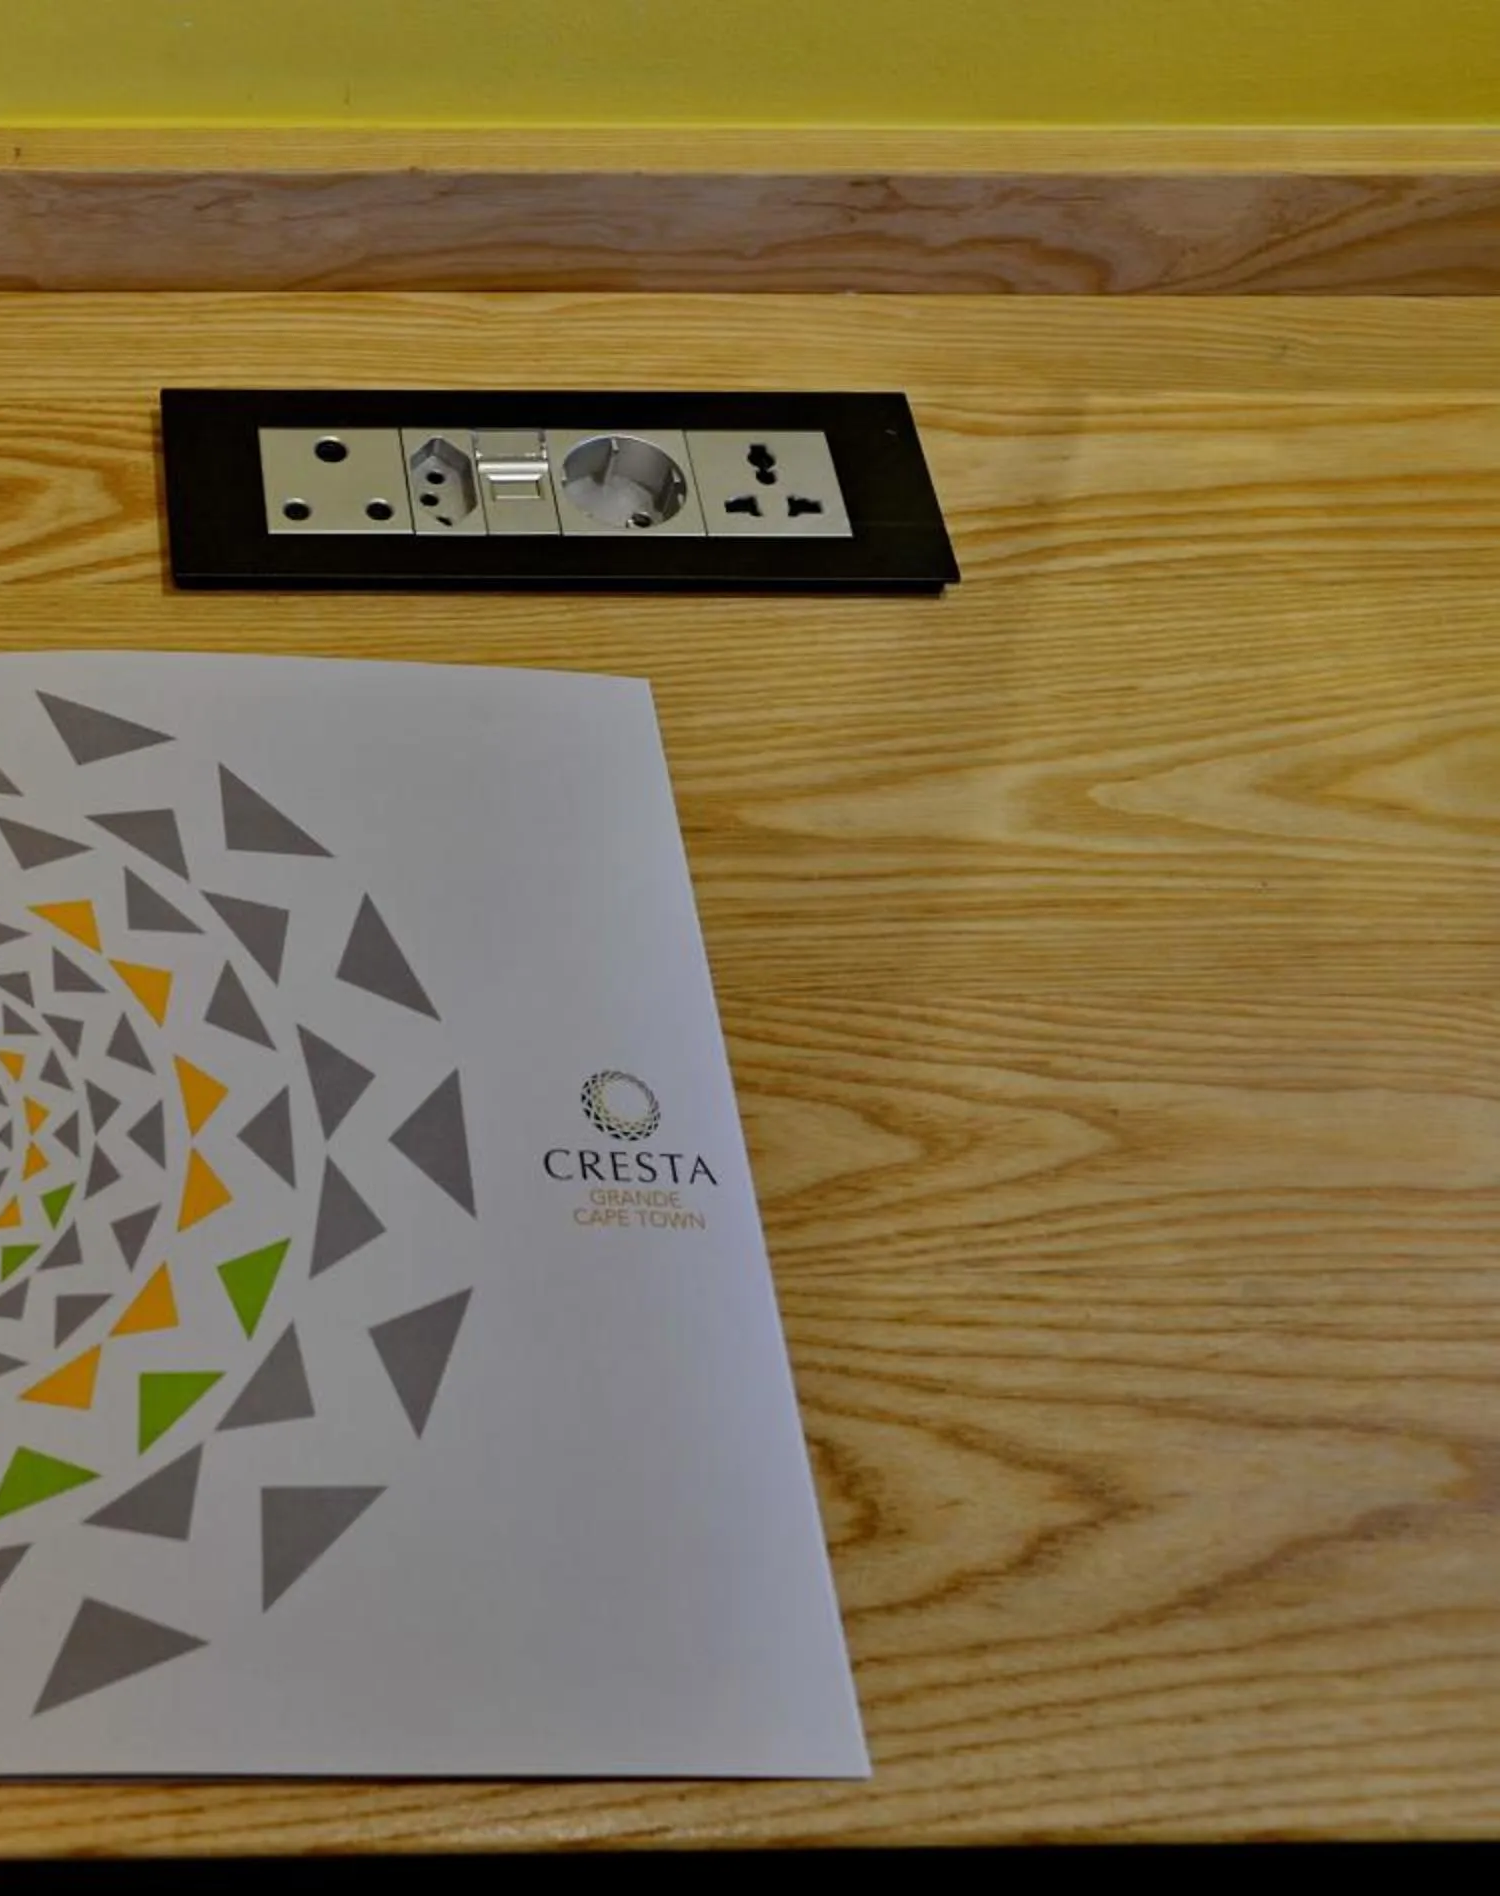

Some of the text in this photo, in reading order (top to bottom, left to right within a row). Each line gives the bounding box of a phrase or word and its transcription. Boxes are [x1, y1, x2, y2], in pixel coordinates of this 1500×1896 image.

[542, 1147, 719, 1187] CRESTA
[589, 1187, 684, 1210] GRANDE
[572, 1207, 707, 1231] CAPE TOWN
